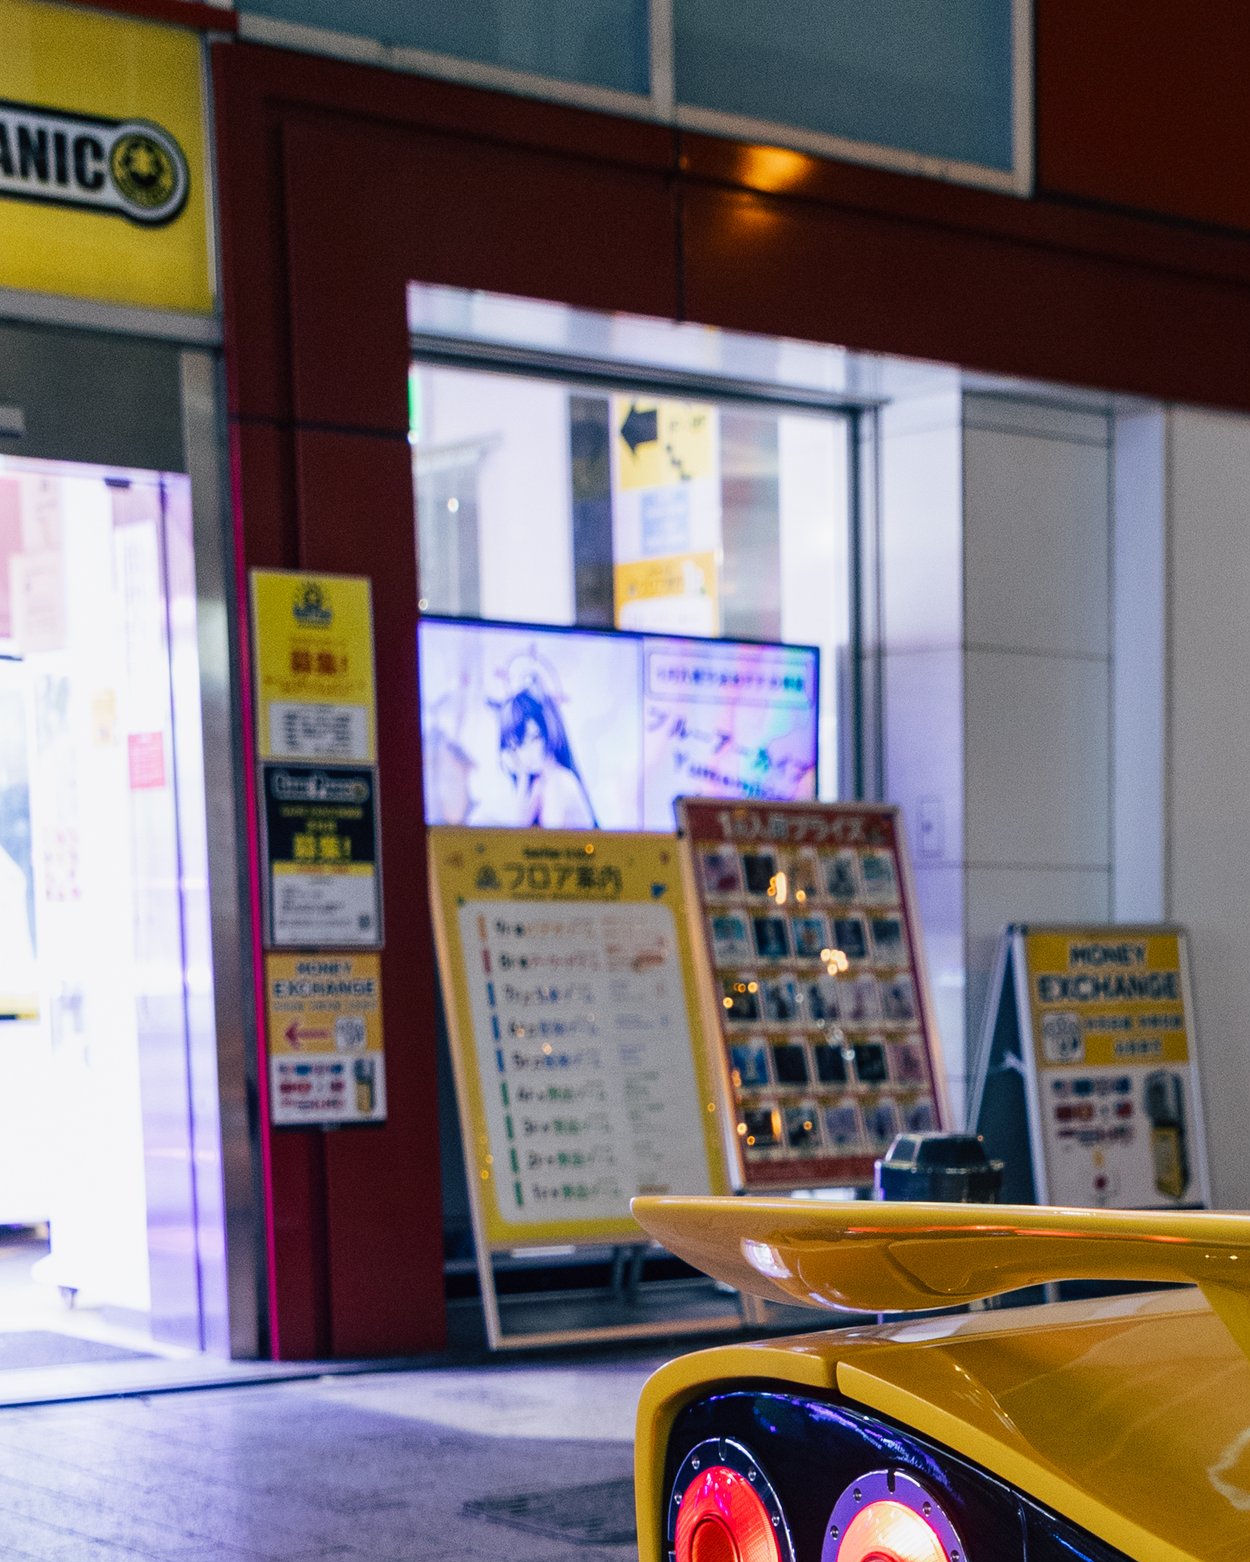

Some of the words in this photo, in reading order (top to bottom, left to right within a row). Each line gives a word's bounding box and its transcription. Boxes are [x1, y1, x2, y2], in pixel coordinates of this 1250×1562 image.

[1070, 943, 1145, 967] MONEY
[297, 961, 351, 974] MONEY
[274, 979, 374, 996] EXCHANGE
[1038, 973, 1178, 1001] EXCHANGE
